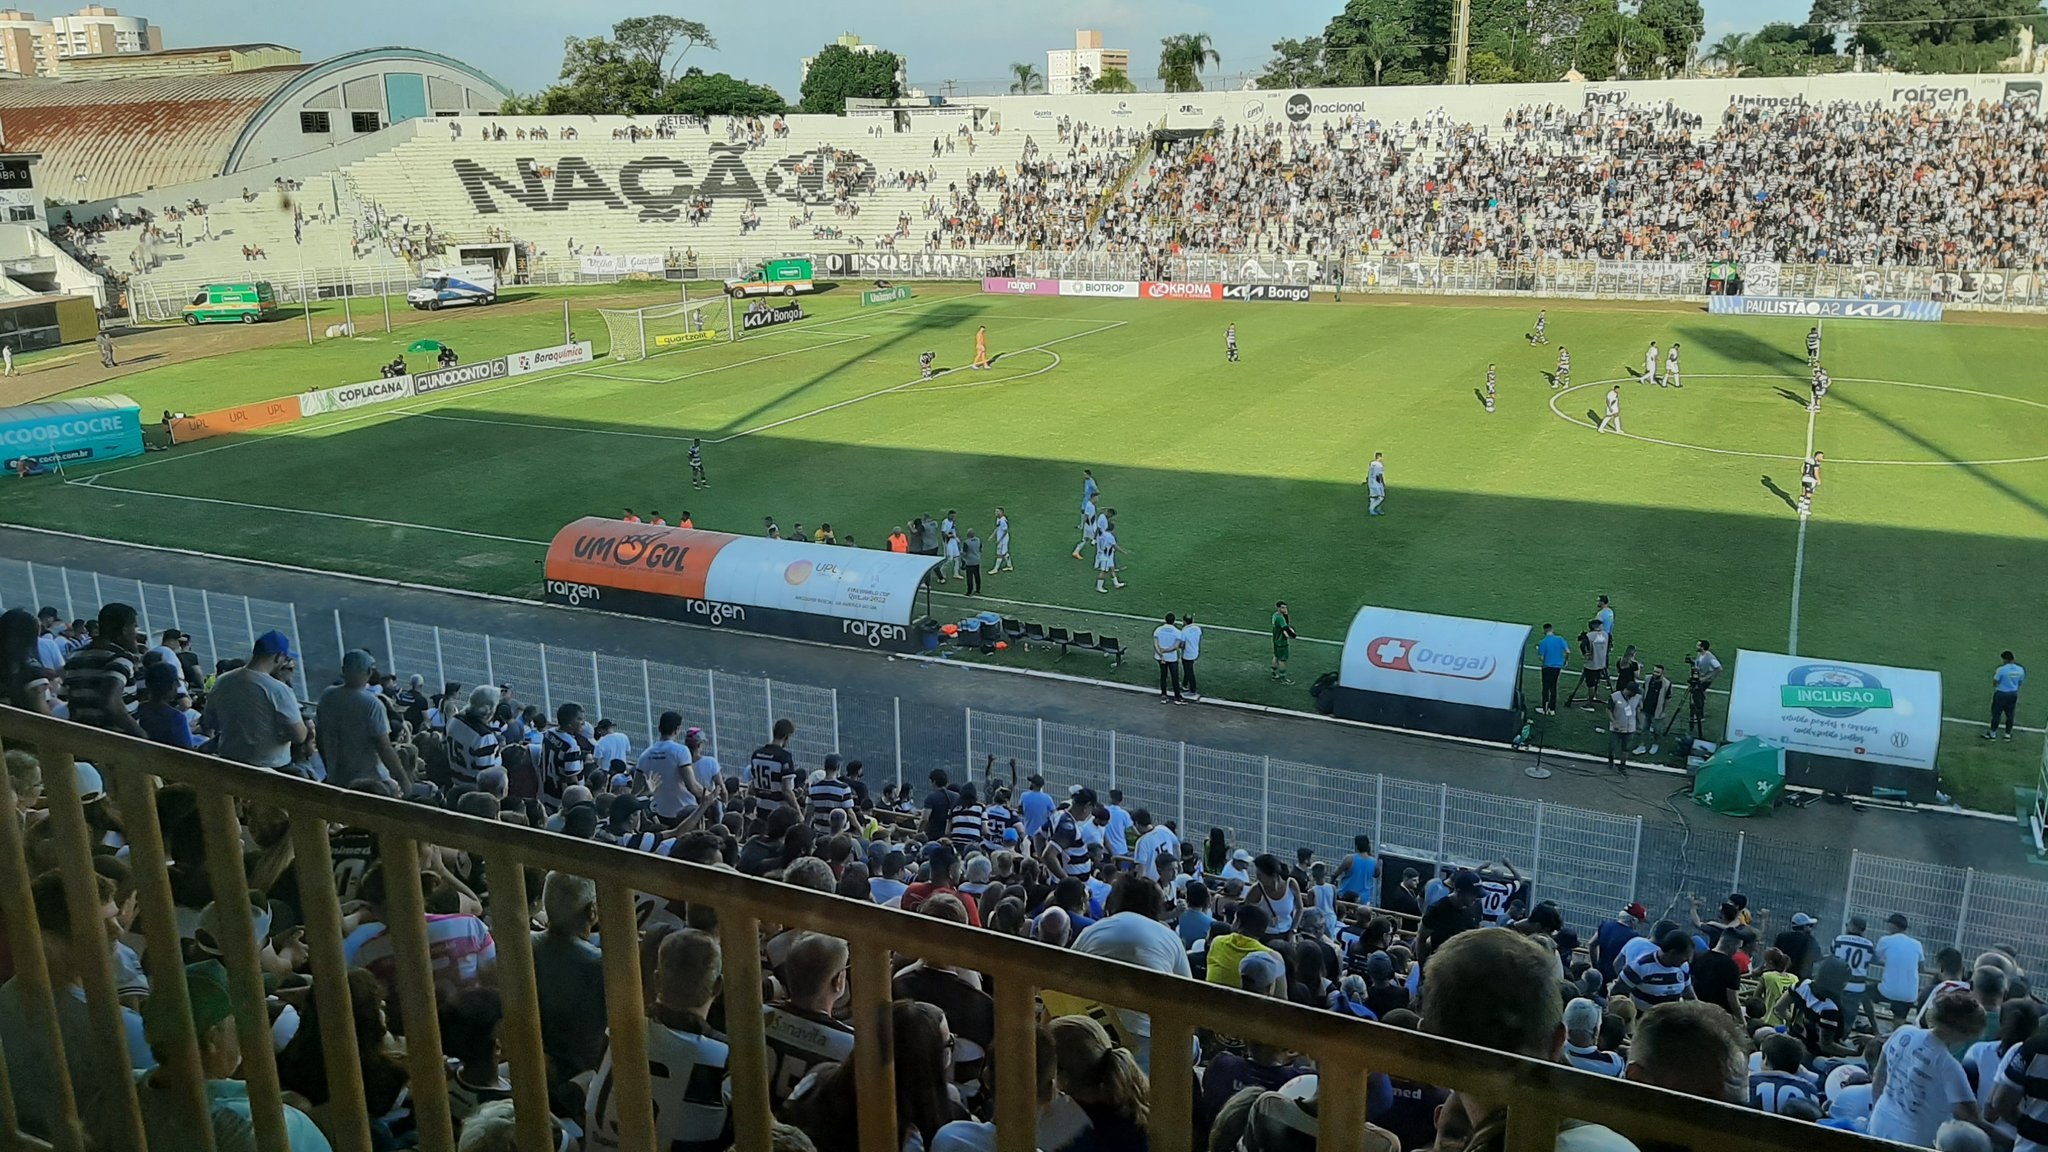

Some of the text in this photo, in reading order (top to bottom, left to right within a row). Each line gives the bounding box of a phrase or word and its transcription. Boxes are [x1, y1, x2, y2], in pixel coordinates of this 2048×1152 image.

[1585, 90, 1627, 107] Poty
[1285, 101, 1366, 115] bet nacional
[452, 142, 768, 223] NAÇÃO
[1086, 282, 1125, 293] BIOTROP
[1169, 283, 1212, 295] KRONA
[1268, 286, 1309, 301] Bongo
[870, 290, 897, 303] Unimed
[774, 308, 799, 322] Bongo
[1745, 299, 1821, 316] PAULISTÃO
[1821, 304, 1840, 317] A2
[428, 364, 491, 388] UNIODONTO
[338, 381, 403, 402] COPLACANA
[228, 411, 248, 423] UPL
[266, 404, 286, 416] UPL
[61, 415, 124, 439] COCRE
[188, 419, 209, 431] UPL
[39, 449, 89, 464] cocre.com.br
[645, 543, 691, 572] GOL
[814, 562, 839, 574] UPL
[1416, 648, 1489, 672] Drogal
[755, 763, 771, 790] 15
[1484, 892, 1500, 911] 10
[1845, 948, 1863, 969] 10
[771, 1015, 828, 1048] Sanavita
